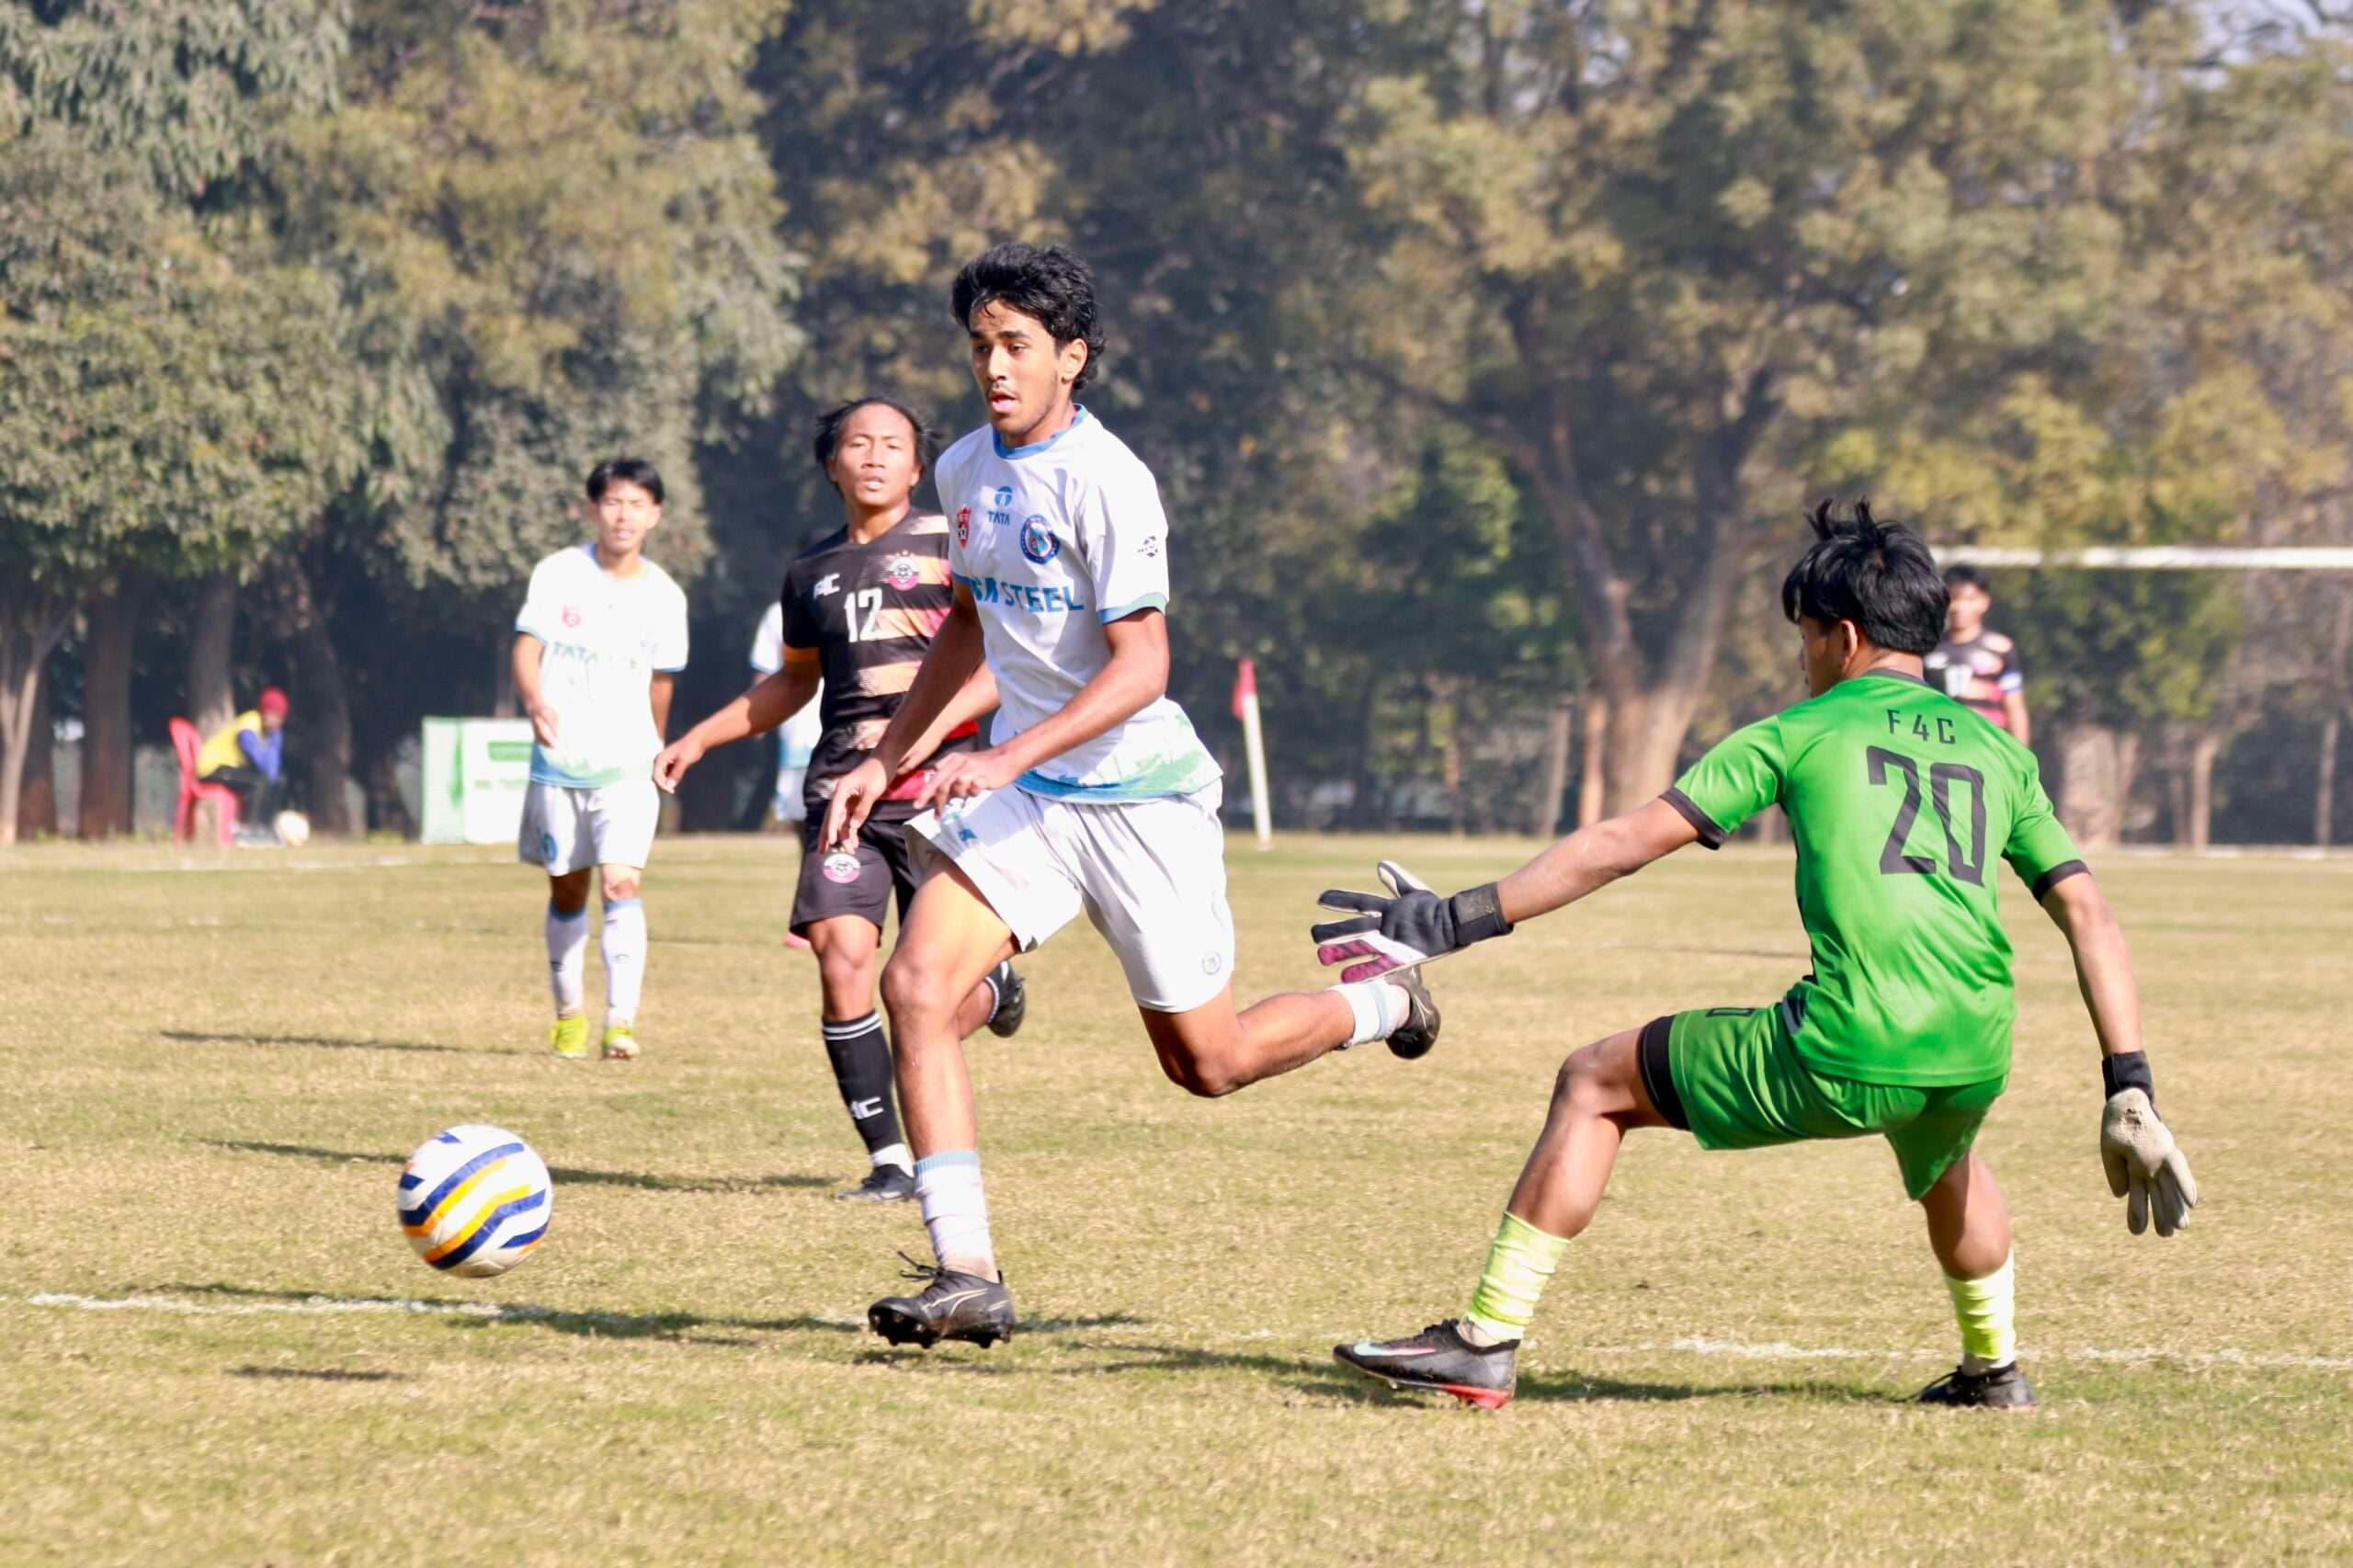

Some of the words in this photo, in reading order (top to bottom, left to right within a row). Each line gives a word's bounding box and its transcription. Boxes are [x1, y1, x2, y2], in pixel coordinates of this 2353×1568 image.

[988, 511, 1010, 526] TATA
[844, 587, 882, 642] 12
[1000, 581, 1085, 613] STEEL
[1887, 709, 1956, 744] F4C
[1866, 745, 1987, 888] 20
